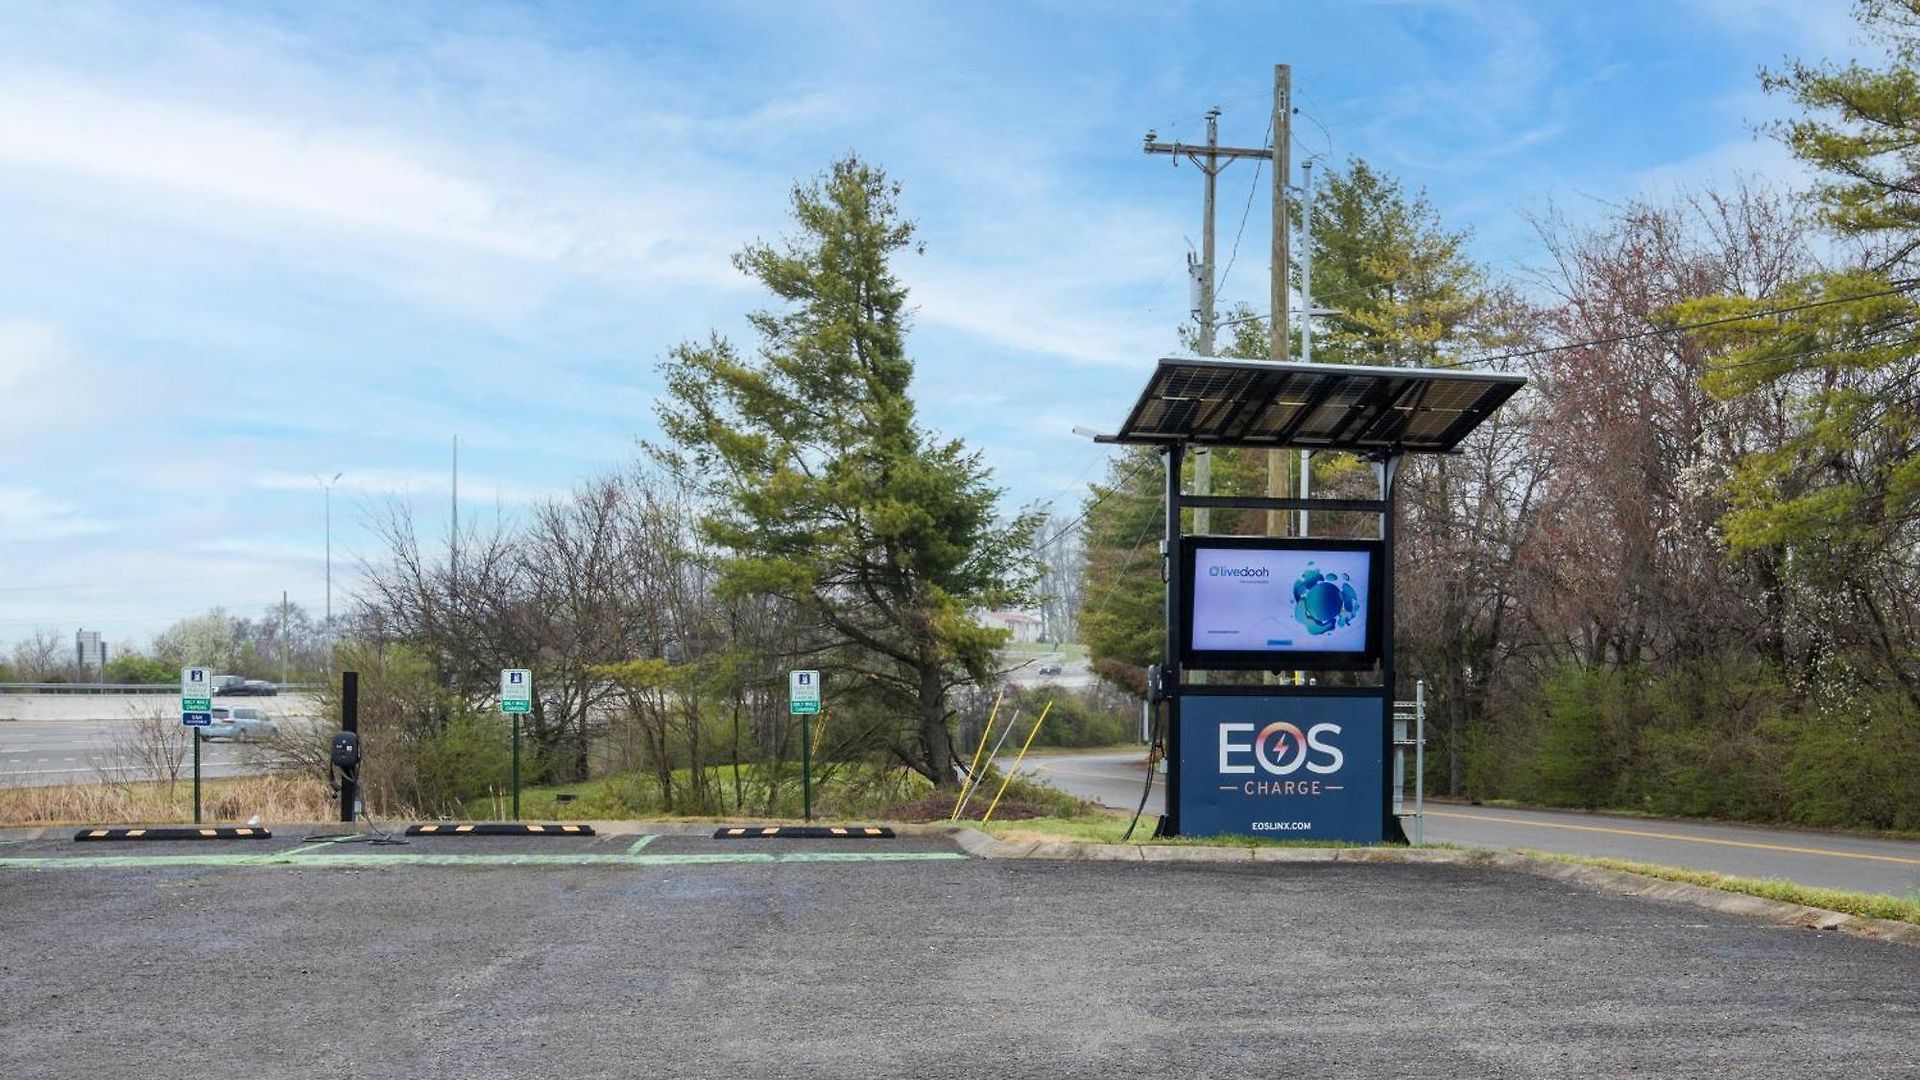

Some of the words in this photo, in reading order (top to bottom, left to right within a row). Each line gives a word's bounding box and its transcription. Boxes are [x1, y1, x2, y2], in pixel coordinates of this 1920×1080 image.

[1220, 566, 1269, 577] livedooh
[1219, 721, 1344, 775] EOS
[1244, 781, 1321, 795] CHARGE
[1252, 822, 1311, 830] EOSLINX.COM
